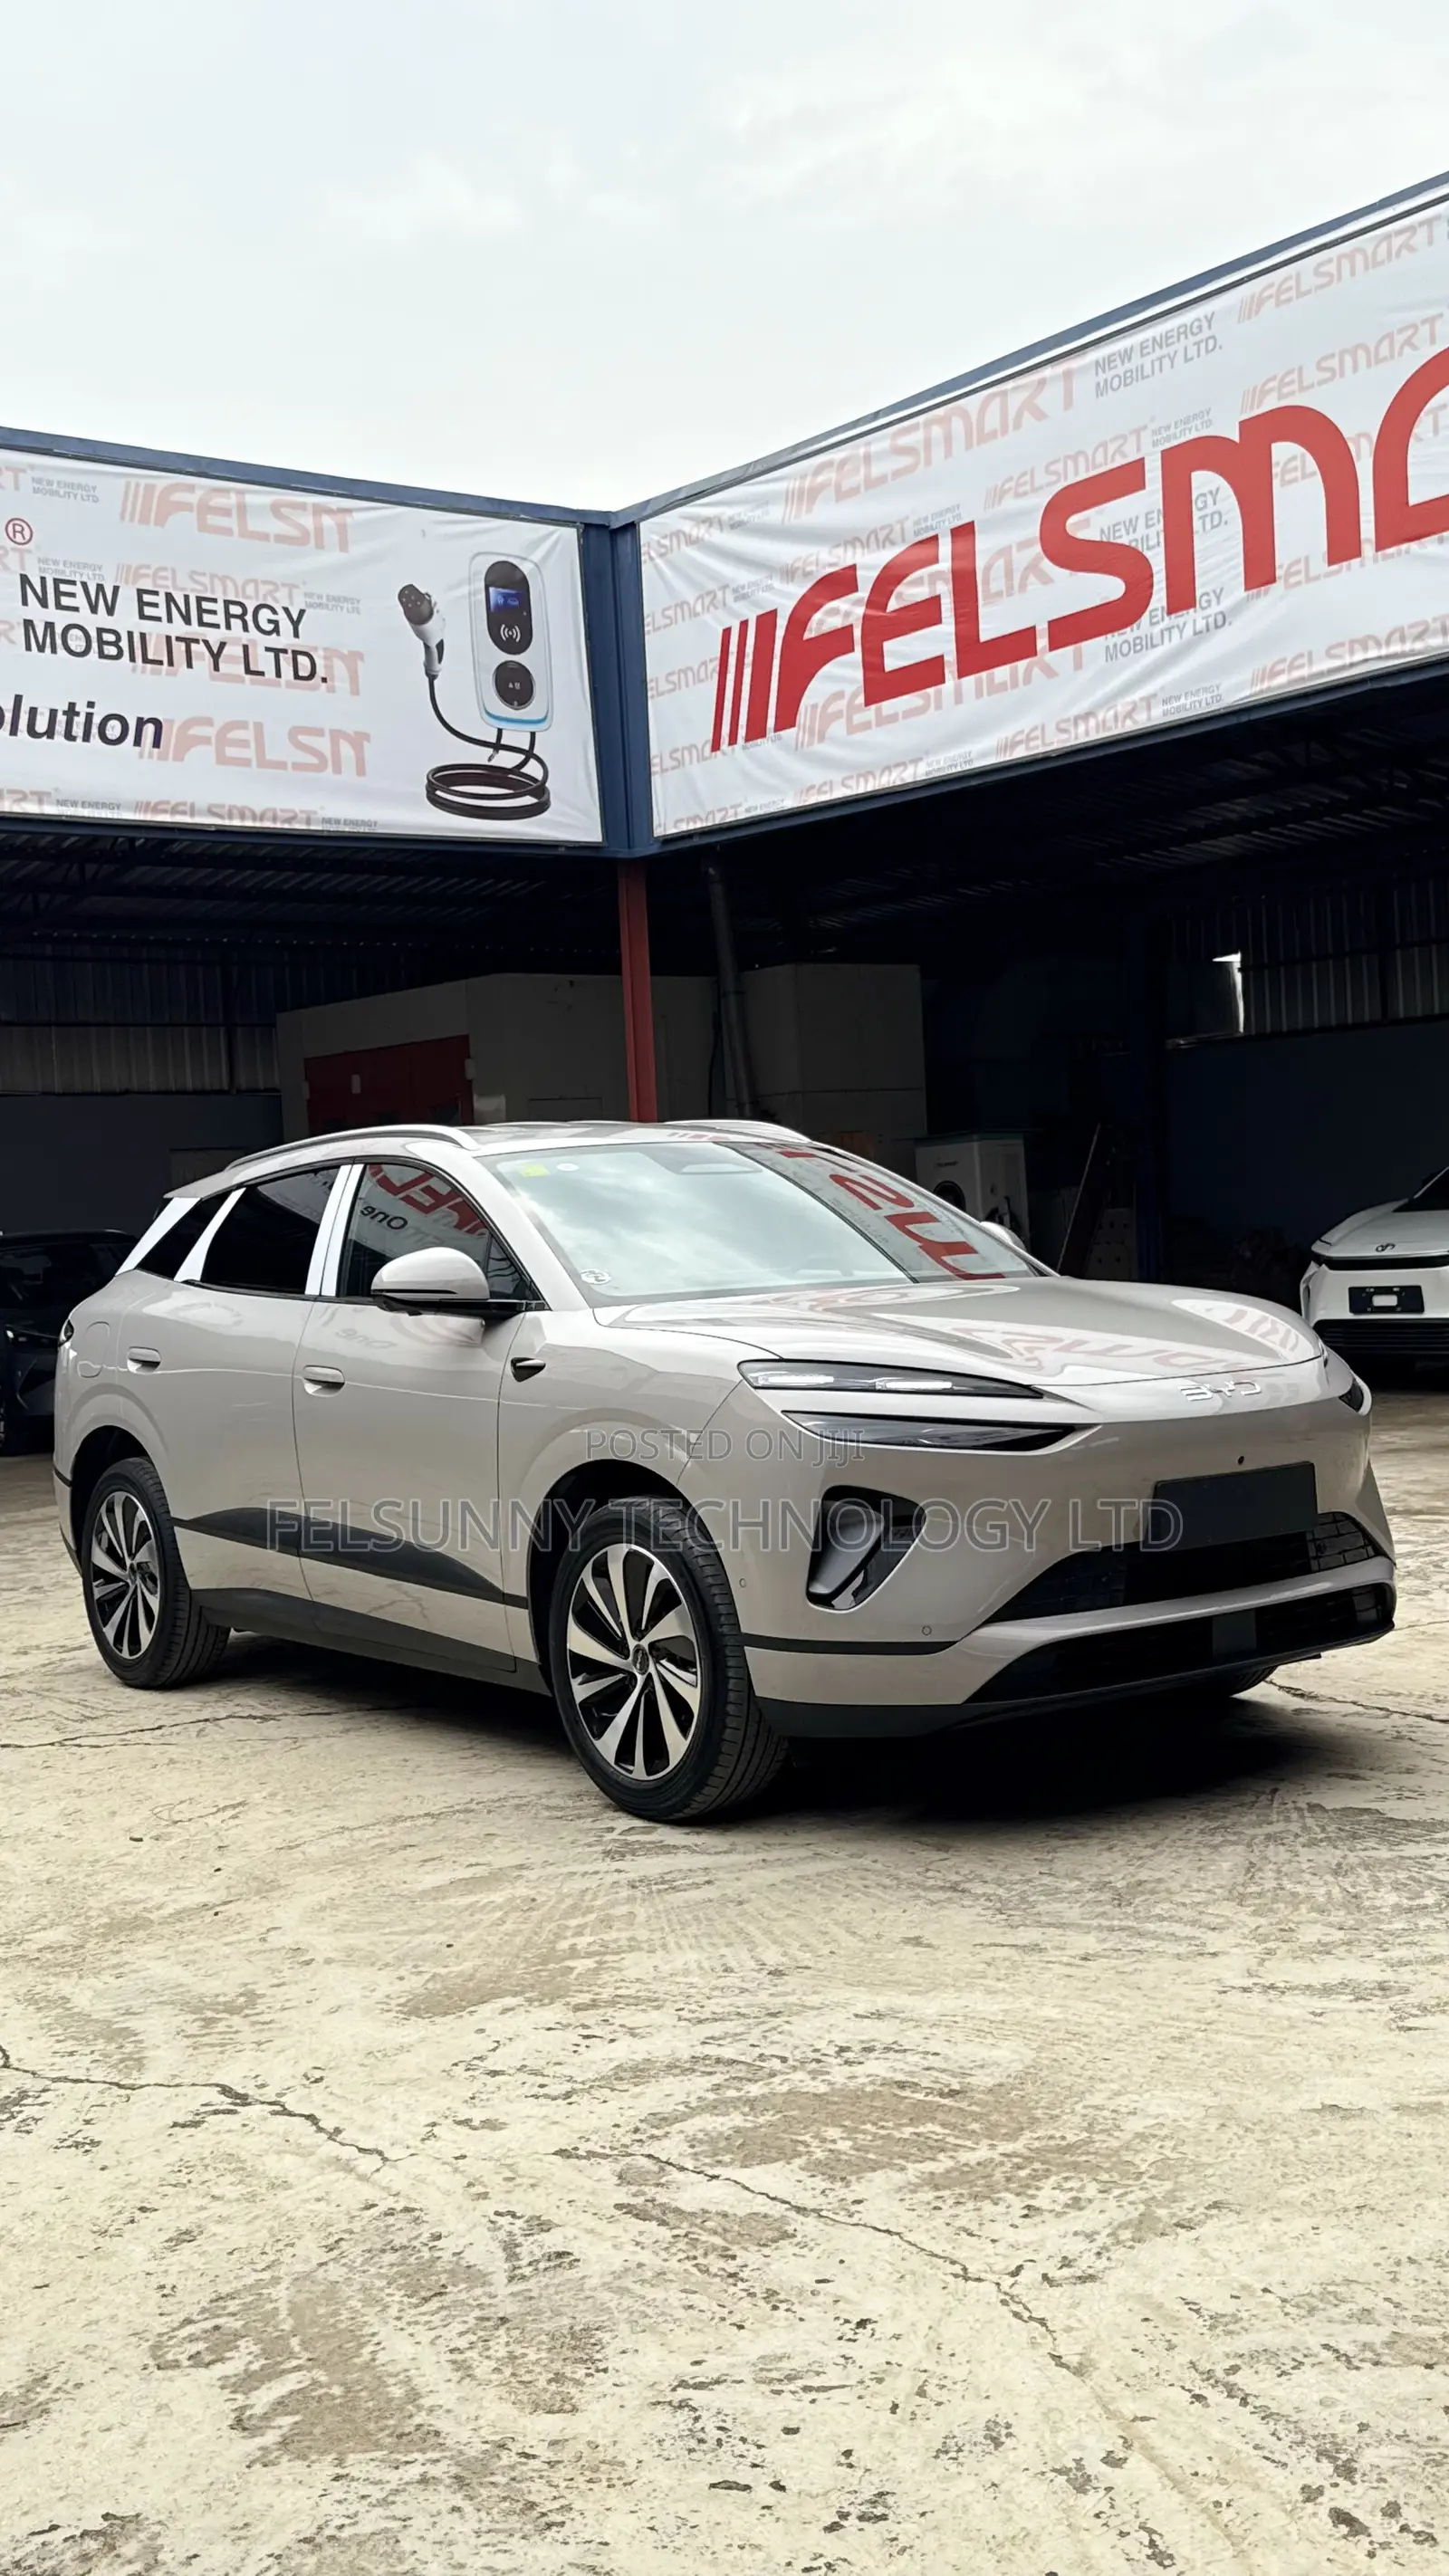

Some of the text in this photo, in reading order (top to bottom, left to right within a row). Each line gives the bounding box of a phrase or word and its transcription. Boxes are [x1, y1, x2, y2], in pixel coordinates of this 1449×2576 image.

[1095, 311, 1215, 378] NEW ENERGY
[1095, 335, 1223, 398] MOBILITY LTD.
[1240, 313, 1444, 416] FELSMART
[1152, 407, 1212, 436] NEW ENERGY
[32, 476, 97, 493] NEW ENERGY
[37, 557, 103, 572] NEW ENERGY
[19, 573, 120, 618] NEW
[136, 587, 306, 639] ENERGY
[23, 618, 227, 673] MOBILITY
[242, 644, 328, 684] LTD.
[1105, 619, 1187, 663] MOBILITY
[1193, 610, 1233, 637] LTD.
[1162, 684, 1222, 706] NEW ENERGY
[1162, 700, 1203, 717] MOBILITY
[0, 694, 163, 750] lution
[56, 799, 121, 810] NEW ENERGY
[321, 817, 341, 825] NEW
[1177, 1380, 1262, 1402] BYD
